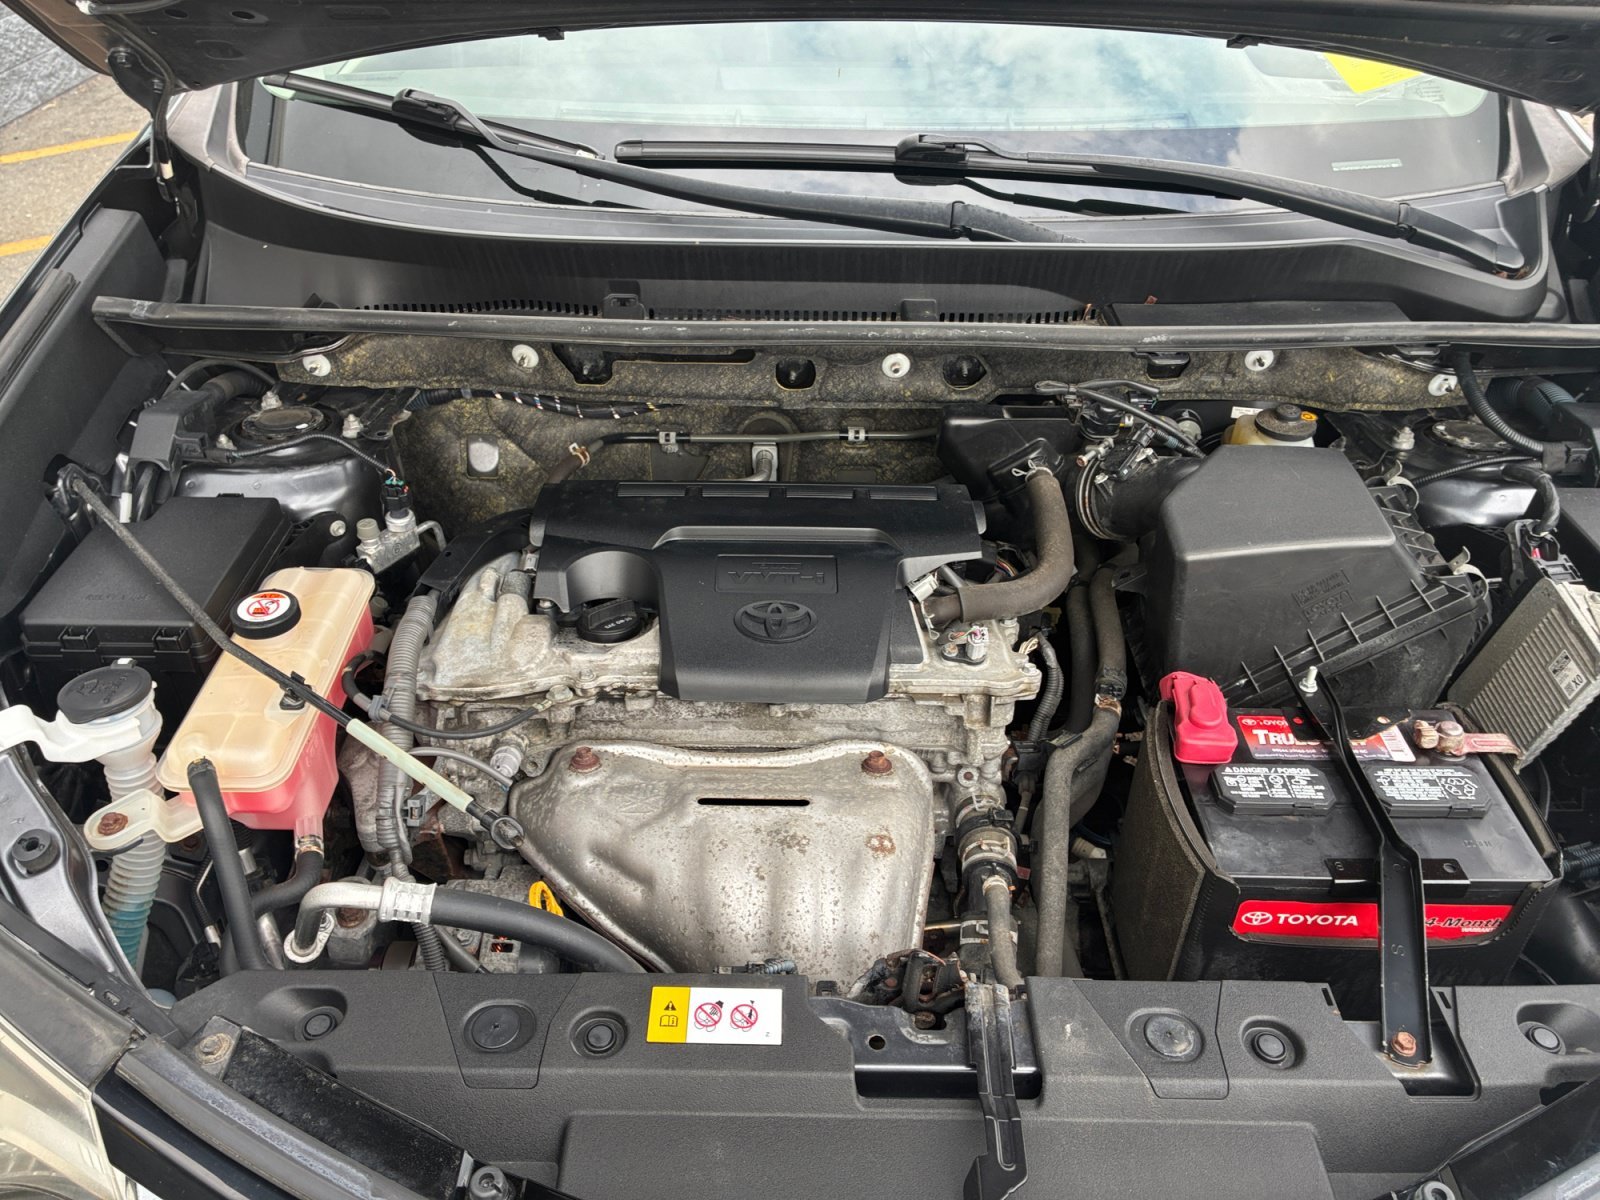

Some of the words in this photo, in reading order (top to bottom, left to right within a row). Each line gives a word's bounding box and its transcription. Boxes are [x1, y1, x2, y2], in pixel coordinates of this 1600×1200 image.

[1232, 766, 1270, 774] DANGER
[1276, 767, 1311, 775] POISON
[1277, 913, 1359, 926] TOYOTA
[1424, 917, 1503, 928] 4-Month
